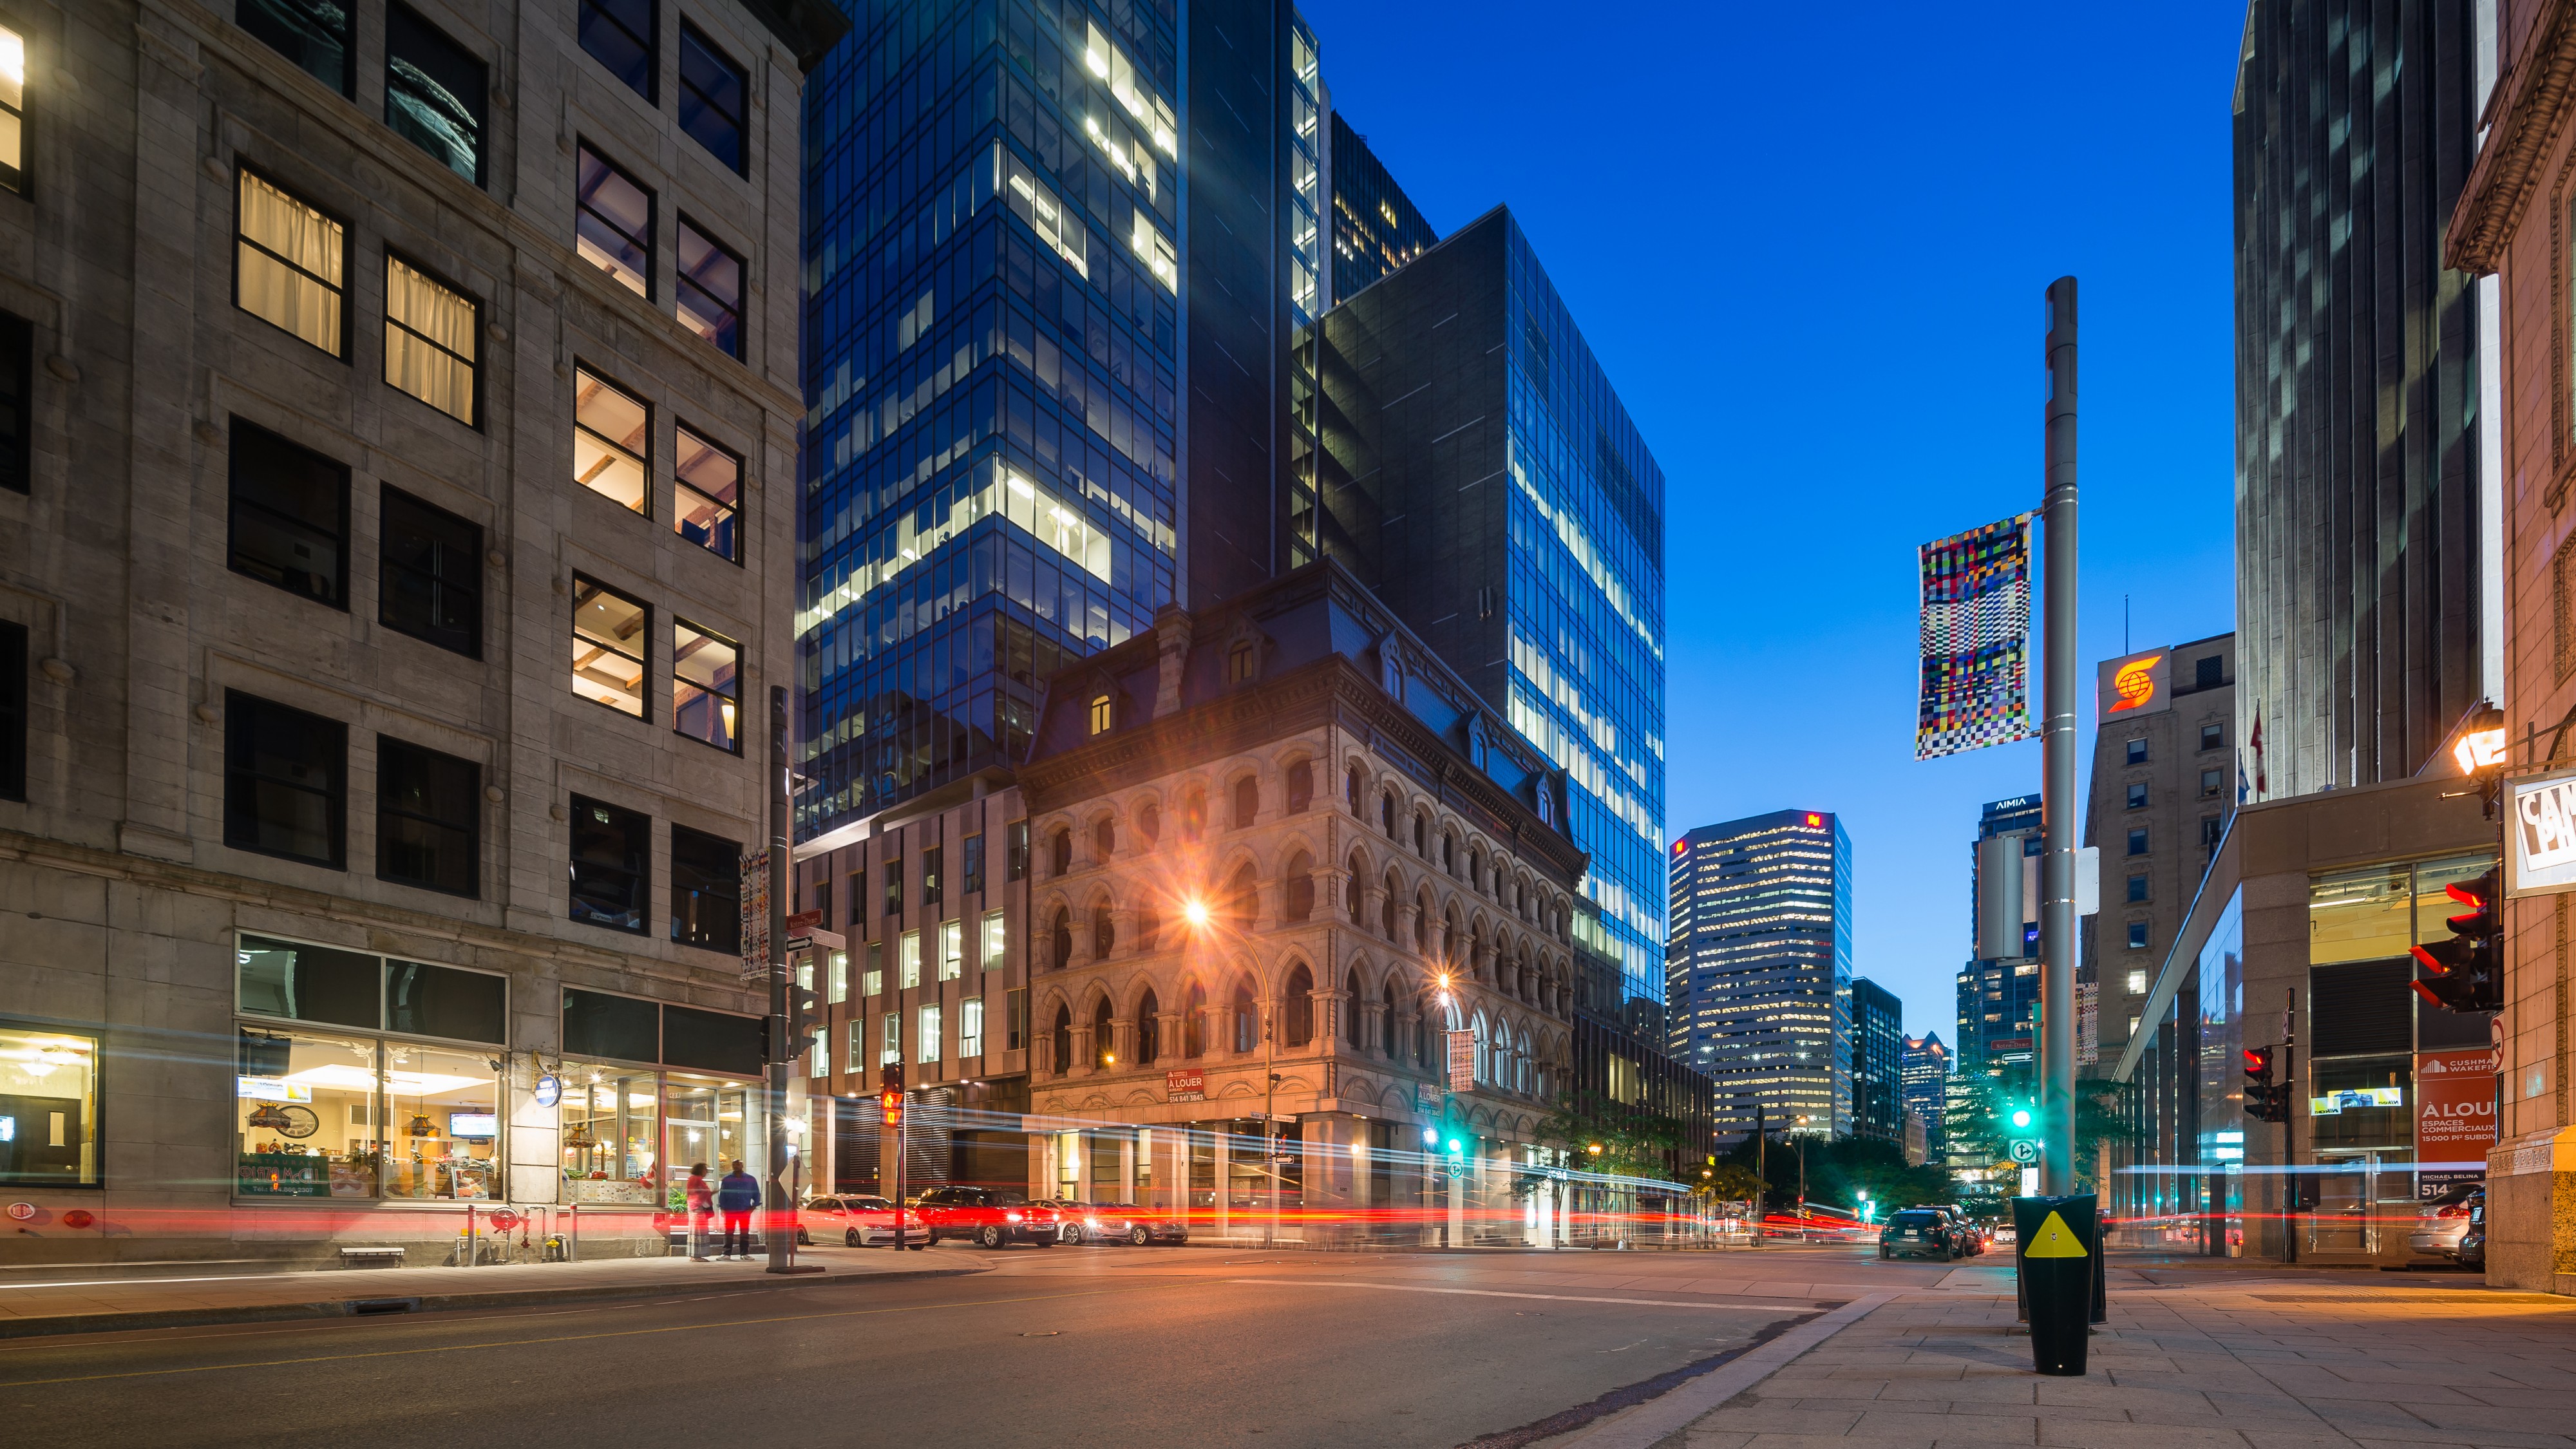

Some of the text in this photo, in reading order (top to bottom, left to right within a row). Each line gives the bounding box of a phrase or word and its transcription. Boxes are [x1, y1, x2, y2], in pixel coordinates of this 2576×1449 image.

[1996, 797, 2026, 810] AIMIA
[1175, 1077, 1202, 1088] LOUER
[1423, 1092, 1441, 1103] LOUER
[2421, 1101, 2440, 1118] À
[2421, 1119, 2465, 1128] ESPACES
[2421, 1124, 2496, 1133] COMMERCIAUX
[2421, 1184, 2448, 1196] 514
